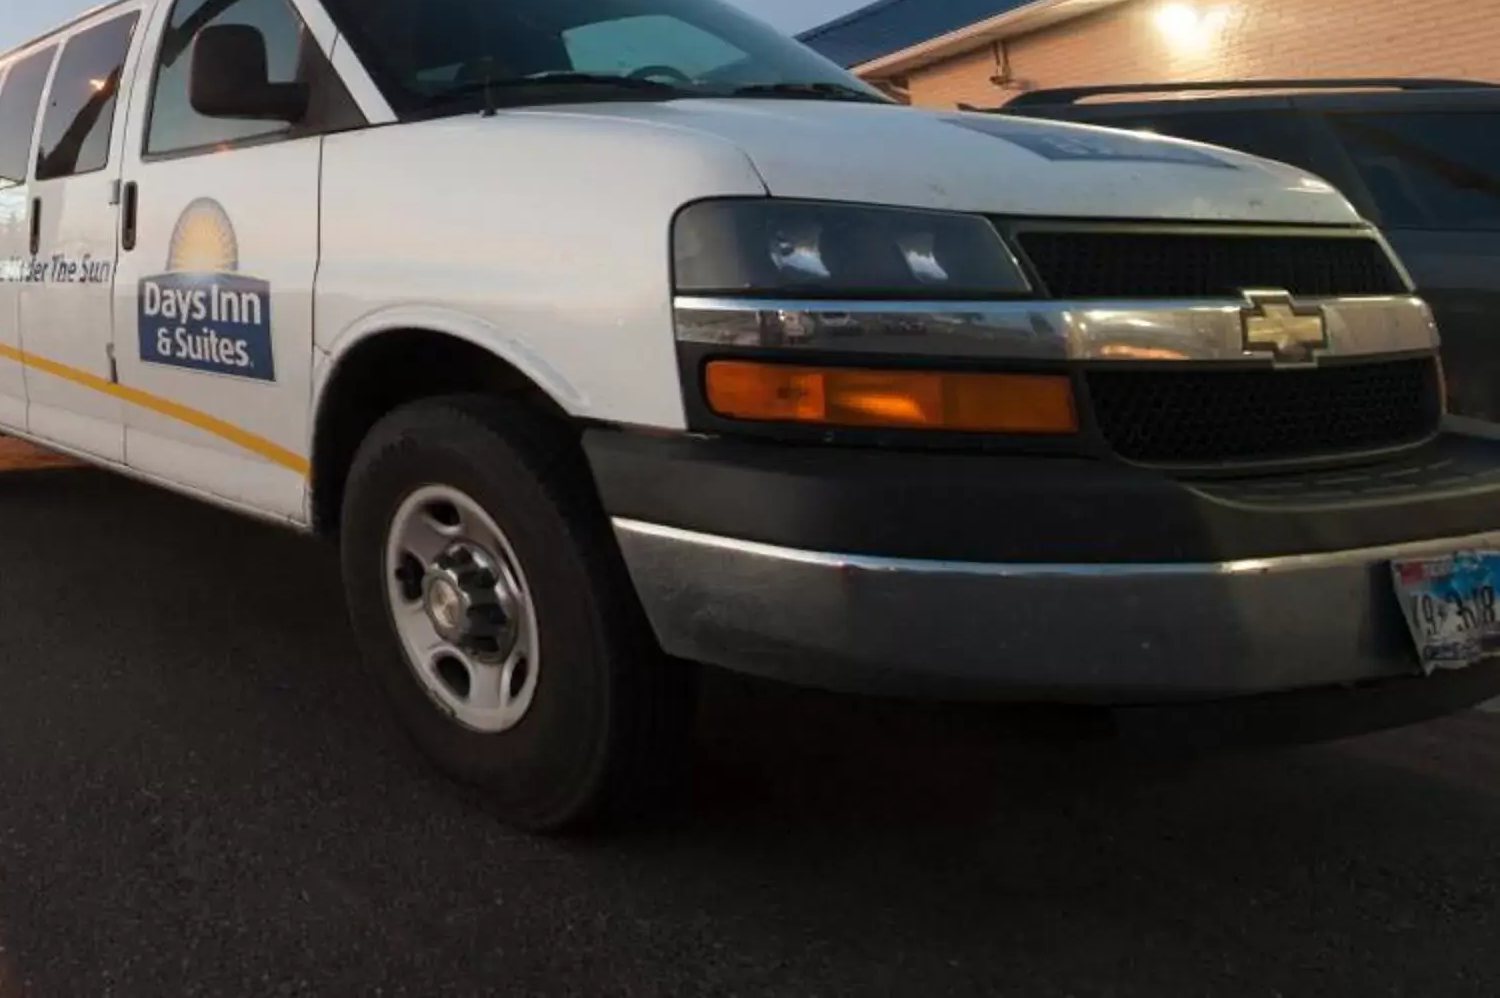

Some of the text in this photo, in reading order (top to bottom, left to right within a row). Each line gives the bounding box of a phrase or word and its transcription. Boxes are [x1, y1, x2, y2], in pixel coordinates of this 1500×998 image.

[51, 254, 75, 283] The
[79, 253, 111, 283] Sun
[143, 281, 261, 325] Days Inn
[157, 327, 250, 368] & Suites
